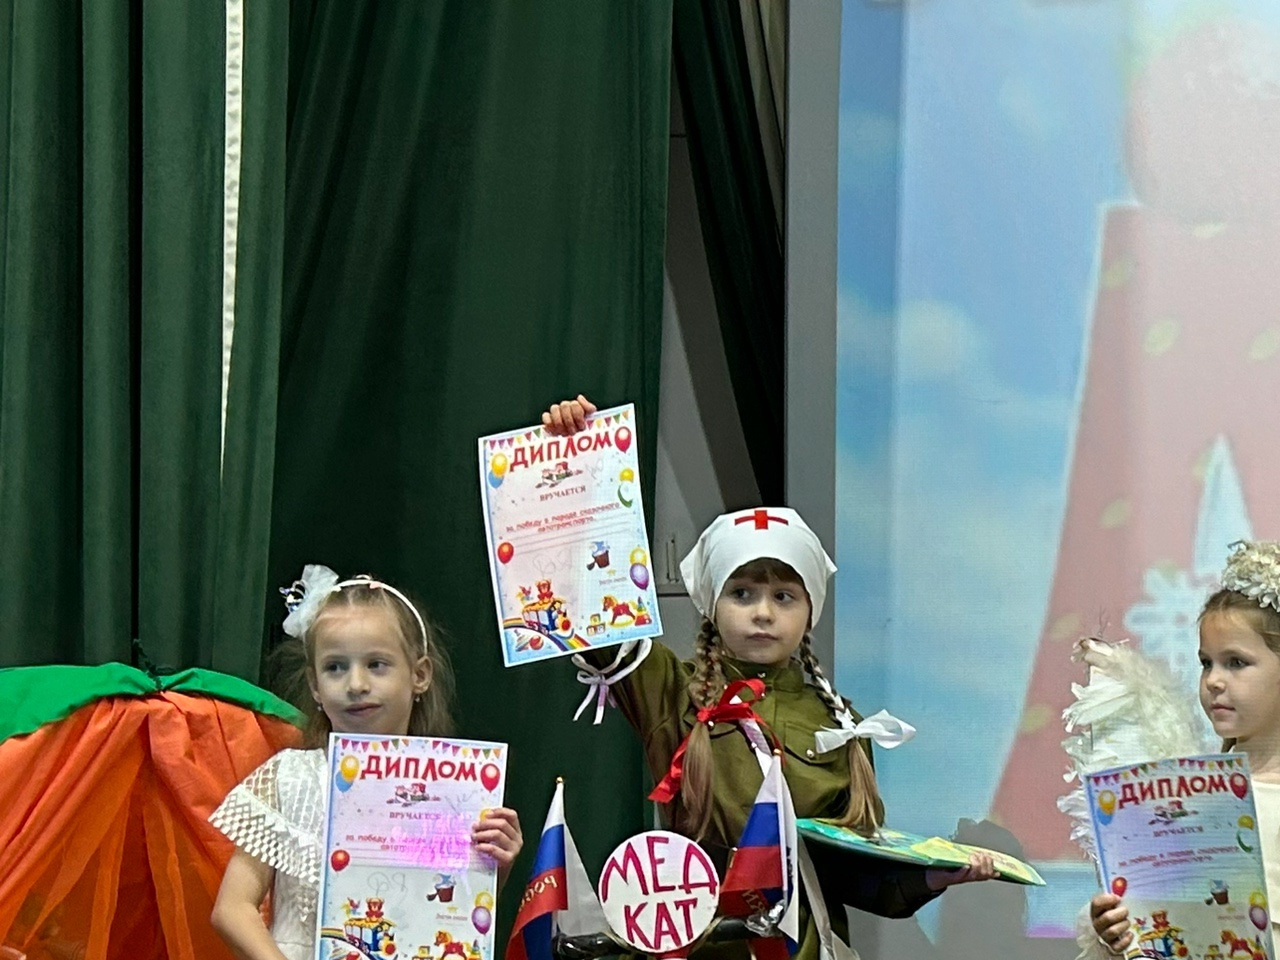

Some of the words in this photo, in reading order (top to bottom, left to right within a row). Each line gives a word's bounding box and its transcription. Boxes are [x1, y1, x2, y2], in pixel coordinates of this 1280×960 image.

[509, 432, 613, 472] ДИПЛОМ
[540, 485, 587, 502] ВРУЧАЕТСЯ
[360, 754, 477, 782] ДИПЛОМ
[1118, 774, 1229, 810] ДИПЛОМ
[601, 835, 718, 904] МЕД
[623, 896, 698, 950] КАТ
